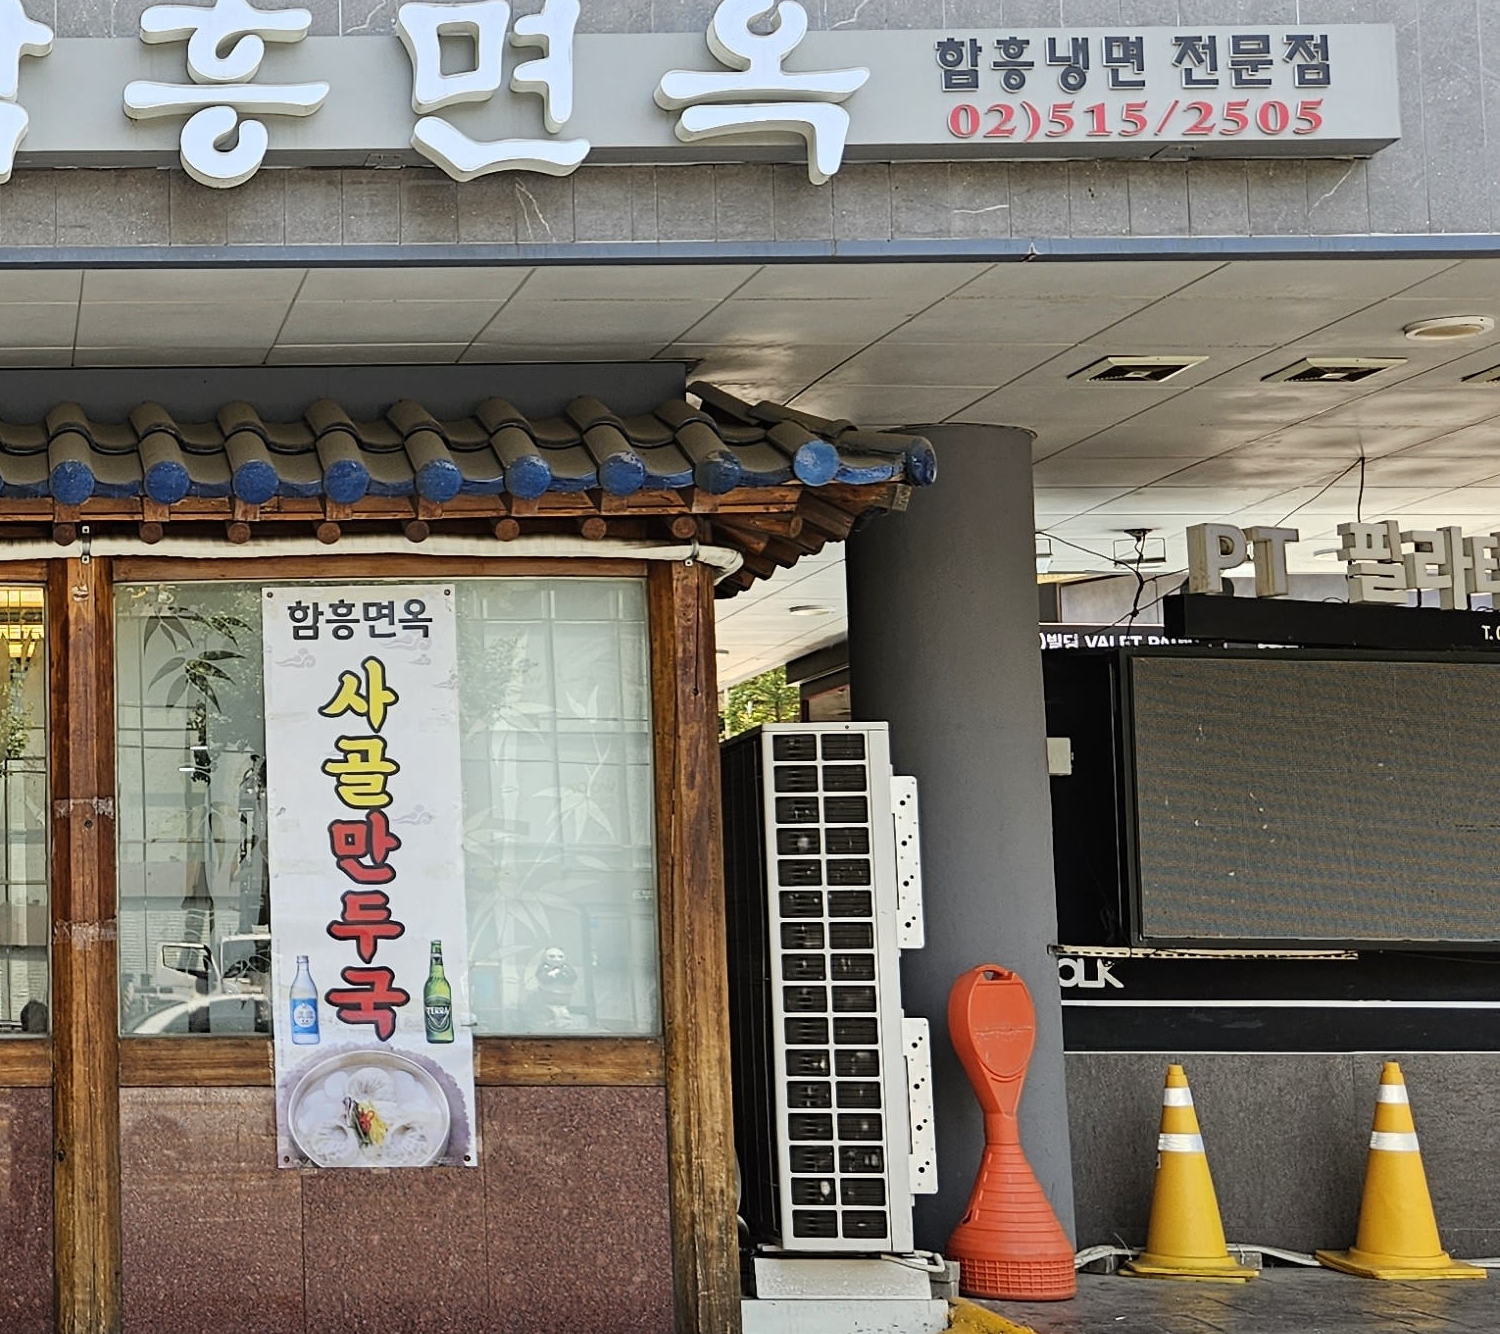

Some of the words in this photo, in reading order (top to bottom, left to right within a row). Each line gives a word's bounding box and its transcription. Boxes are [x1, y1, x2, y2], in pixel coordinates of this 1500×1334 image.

[934, 35, 1146, 93] 함흥냉면
[1171, 33, 1331, 90] 전문점
[947, 98, 1324, 142] 02)515/2505
[1186, 522, 1299, 598] PT
[287, 599, 433, 641] 함흥면옥
[318, 656, 409, 1041] 사골만두국
